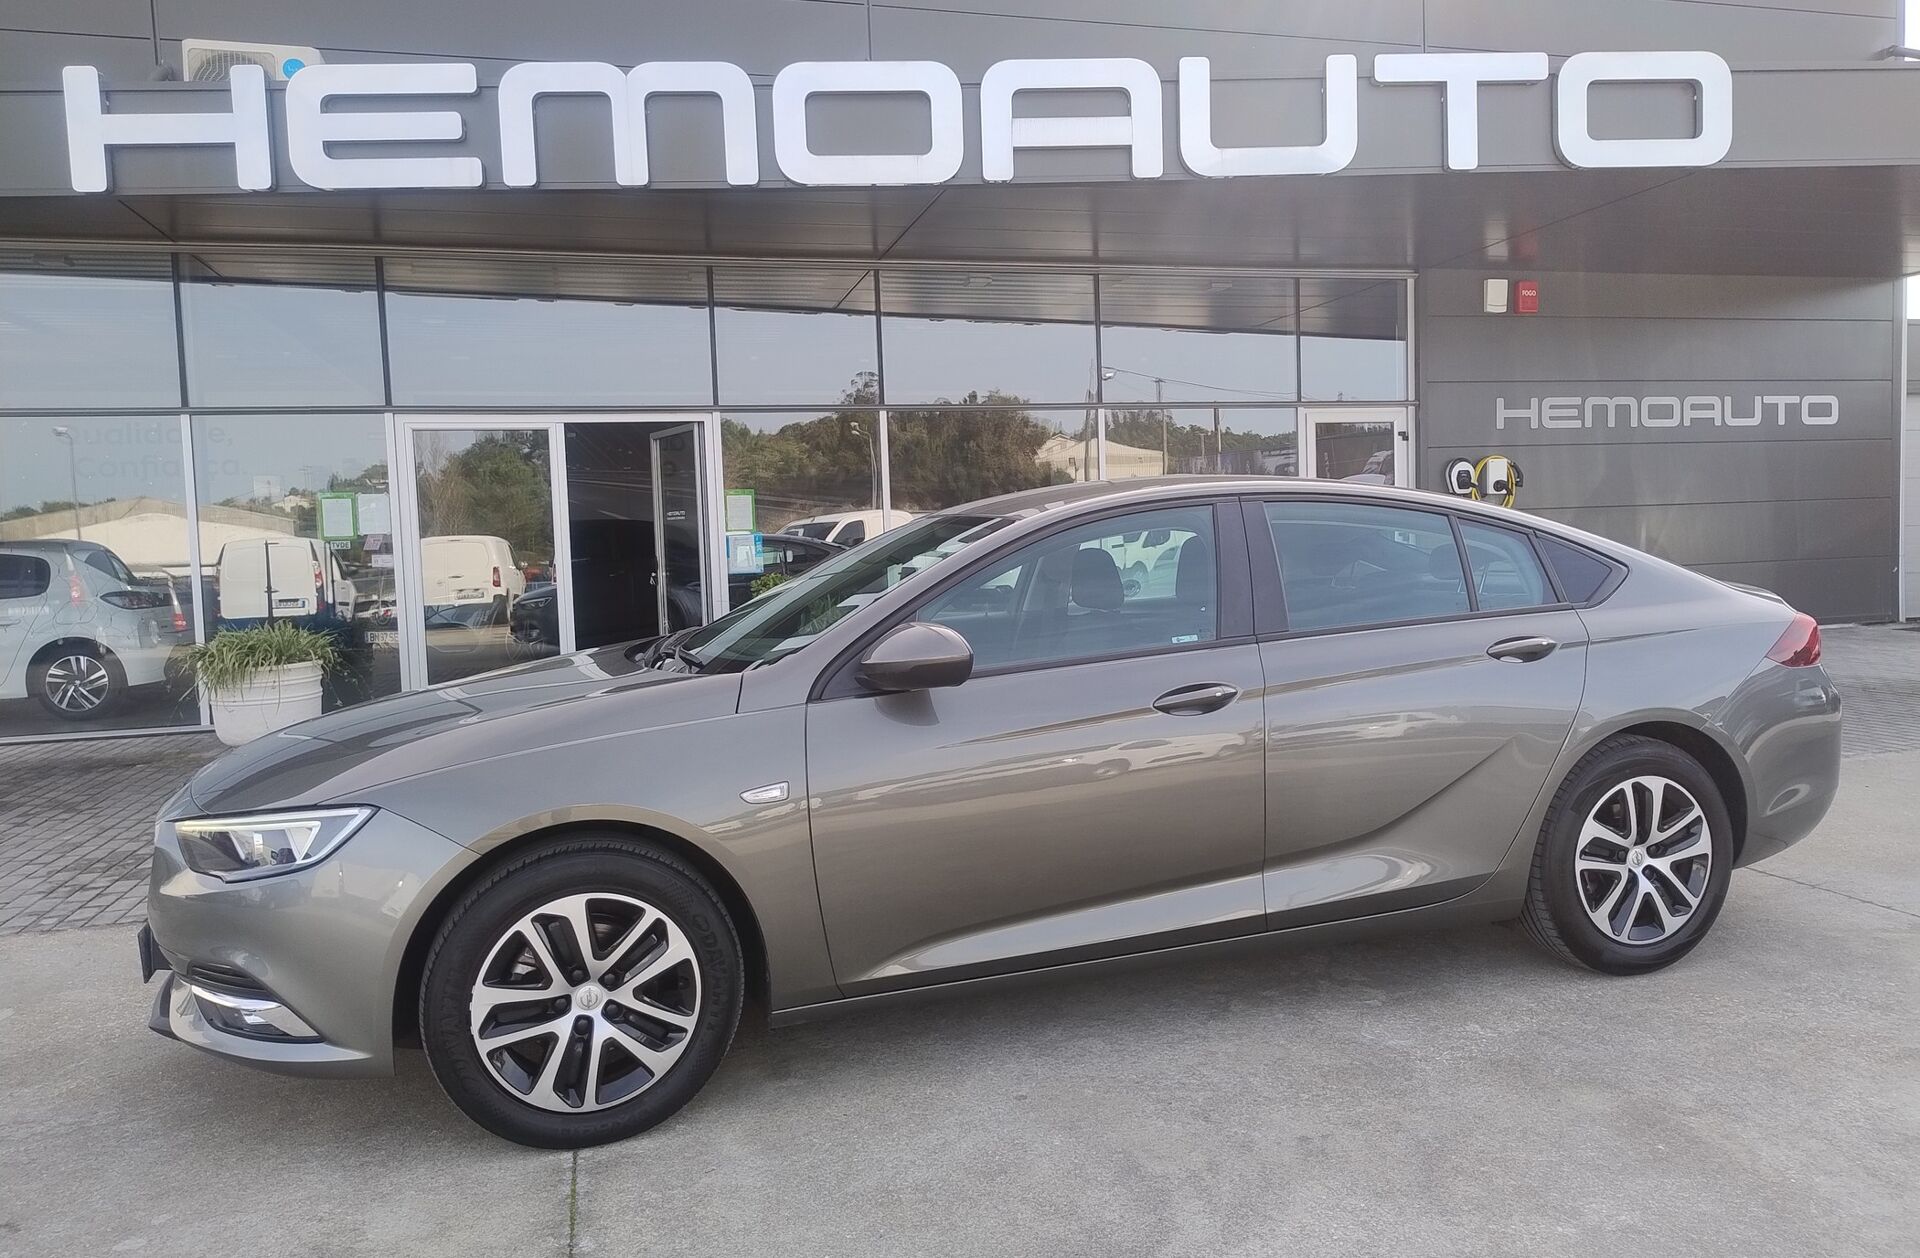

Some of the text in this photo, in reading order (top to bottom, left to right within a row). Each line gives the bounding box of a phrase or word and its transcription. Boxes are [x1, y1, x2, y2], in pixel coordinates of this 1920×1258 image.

[62, 50, 1734, 194] HEMOAUTO
[1521, 289, 1537, 297] FOGO
[1496, 394, 1839, 430] HEMOAUTO
[54, 422, 234, 447] Qualidae,
[76, 454, 248, 483] Confiaça.
[331, 541, 350, 549] TVDE
